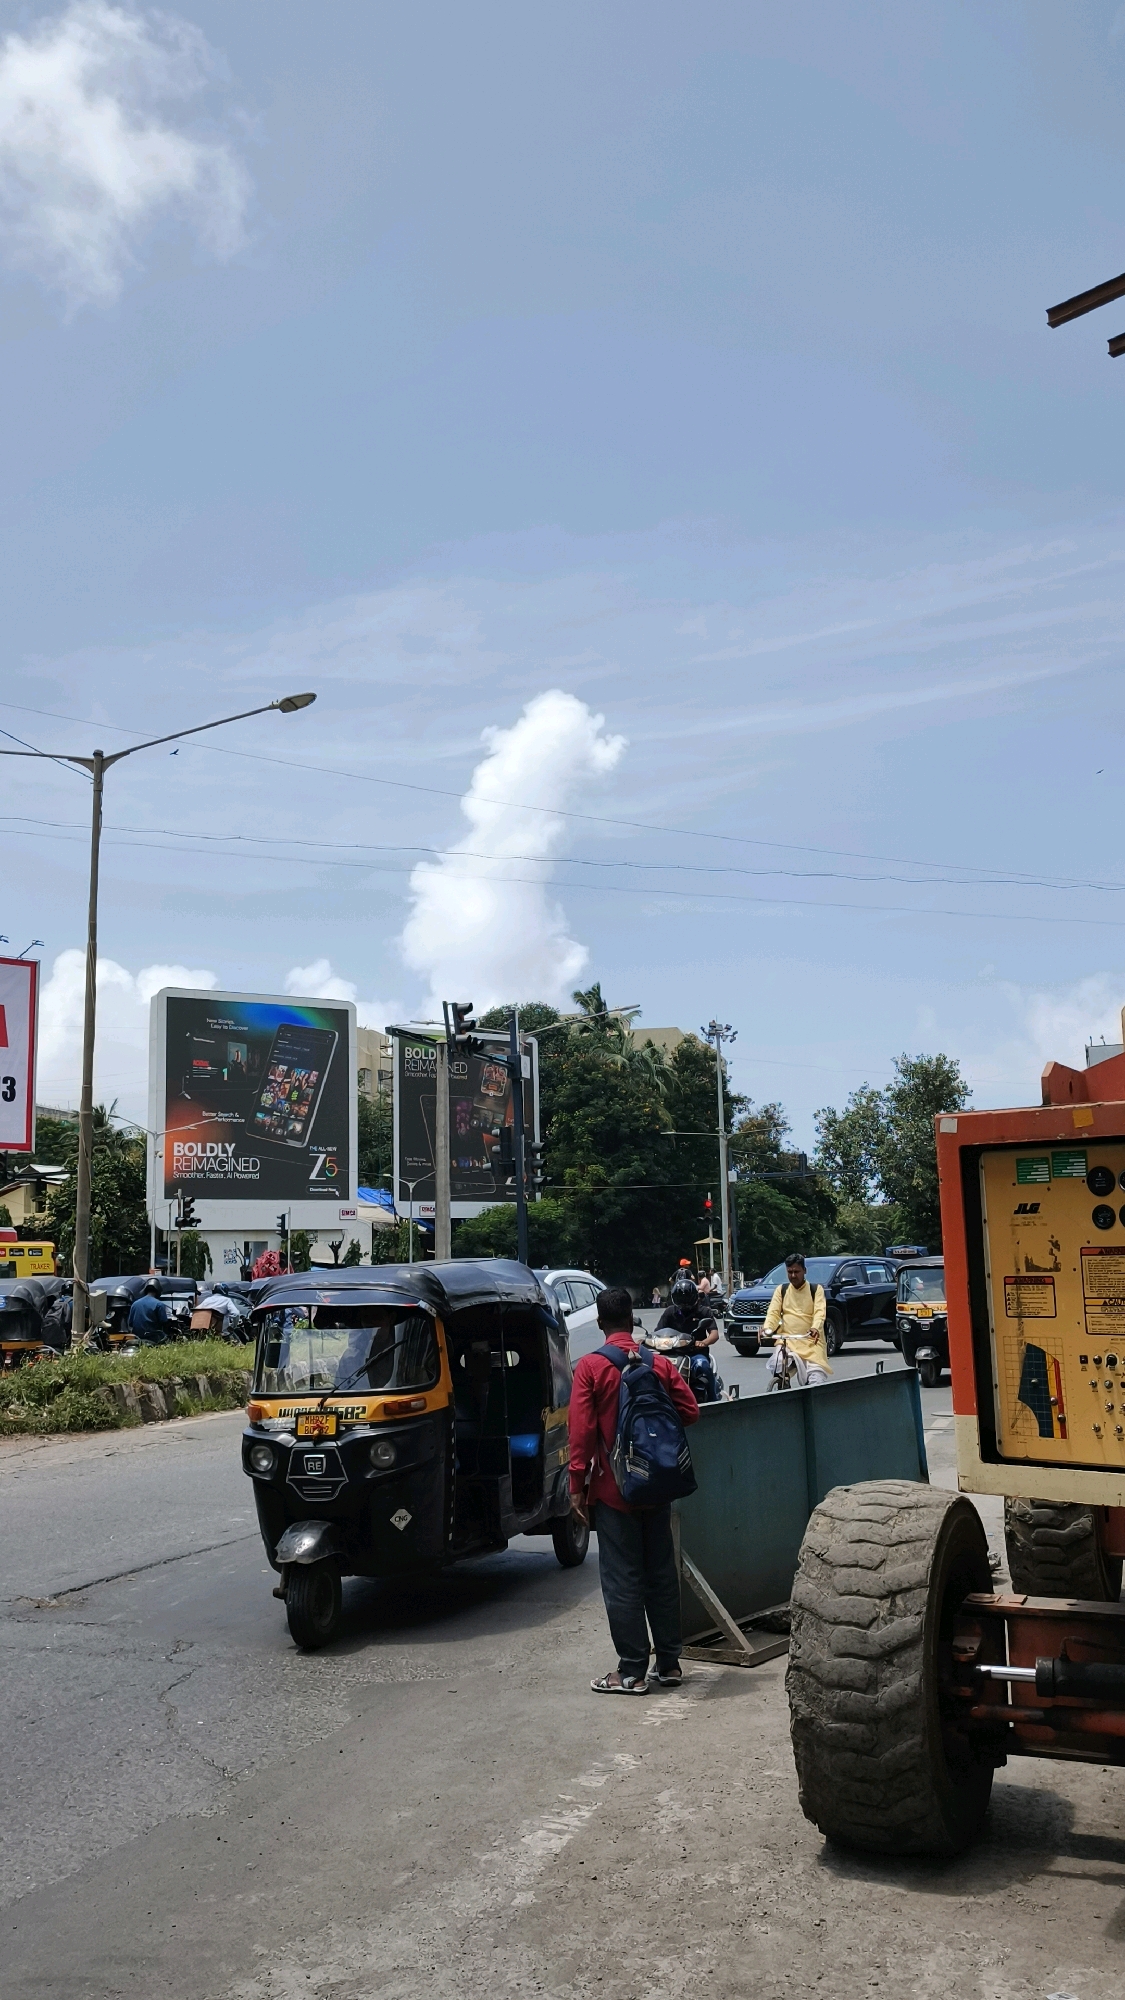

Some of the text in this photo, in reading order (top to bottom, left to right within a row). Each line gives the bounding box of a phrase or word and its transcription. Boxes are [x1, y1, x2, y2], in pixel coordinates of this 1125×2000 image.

[173, 1141, 236, 1157] BOLDLY
[173, 1156, 260, 1172] REIMAGINED
[173, 1171, 205, 1179] Smoother.
[233, 1172, 260, 1180] Powered
[1013, 1203, 1040, 1214] JLG
[307, 1461, 322, 1471] RE
[394, 1514, 408, 1522] CNG
